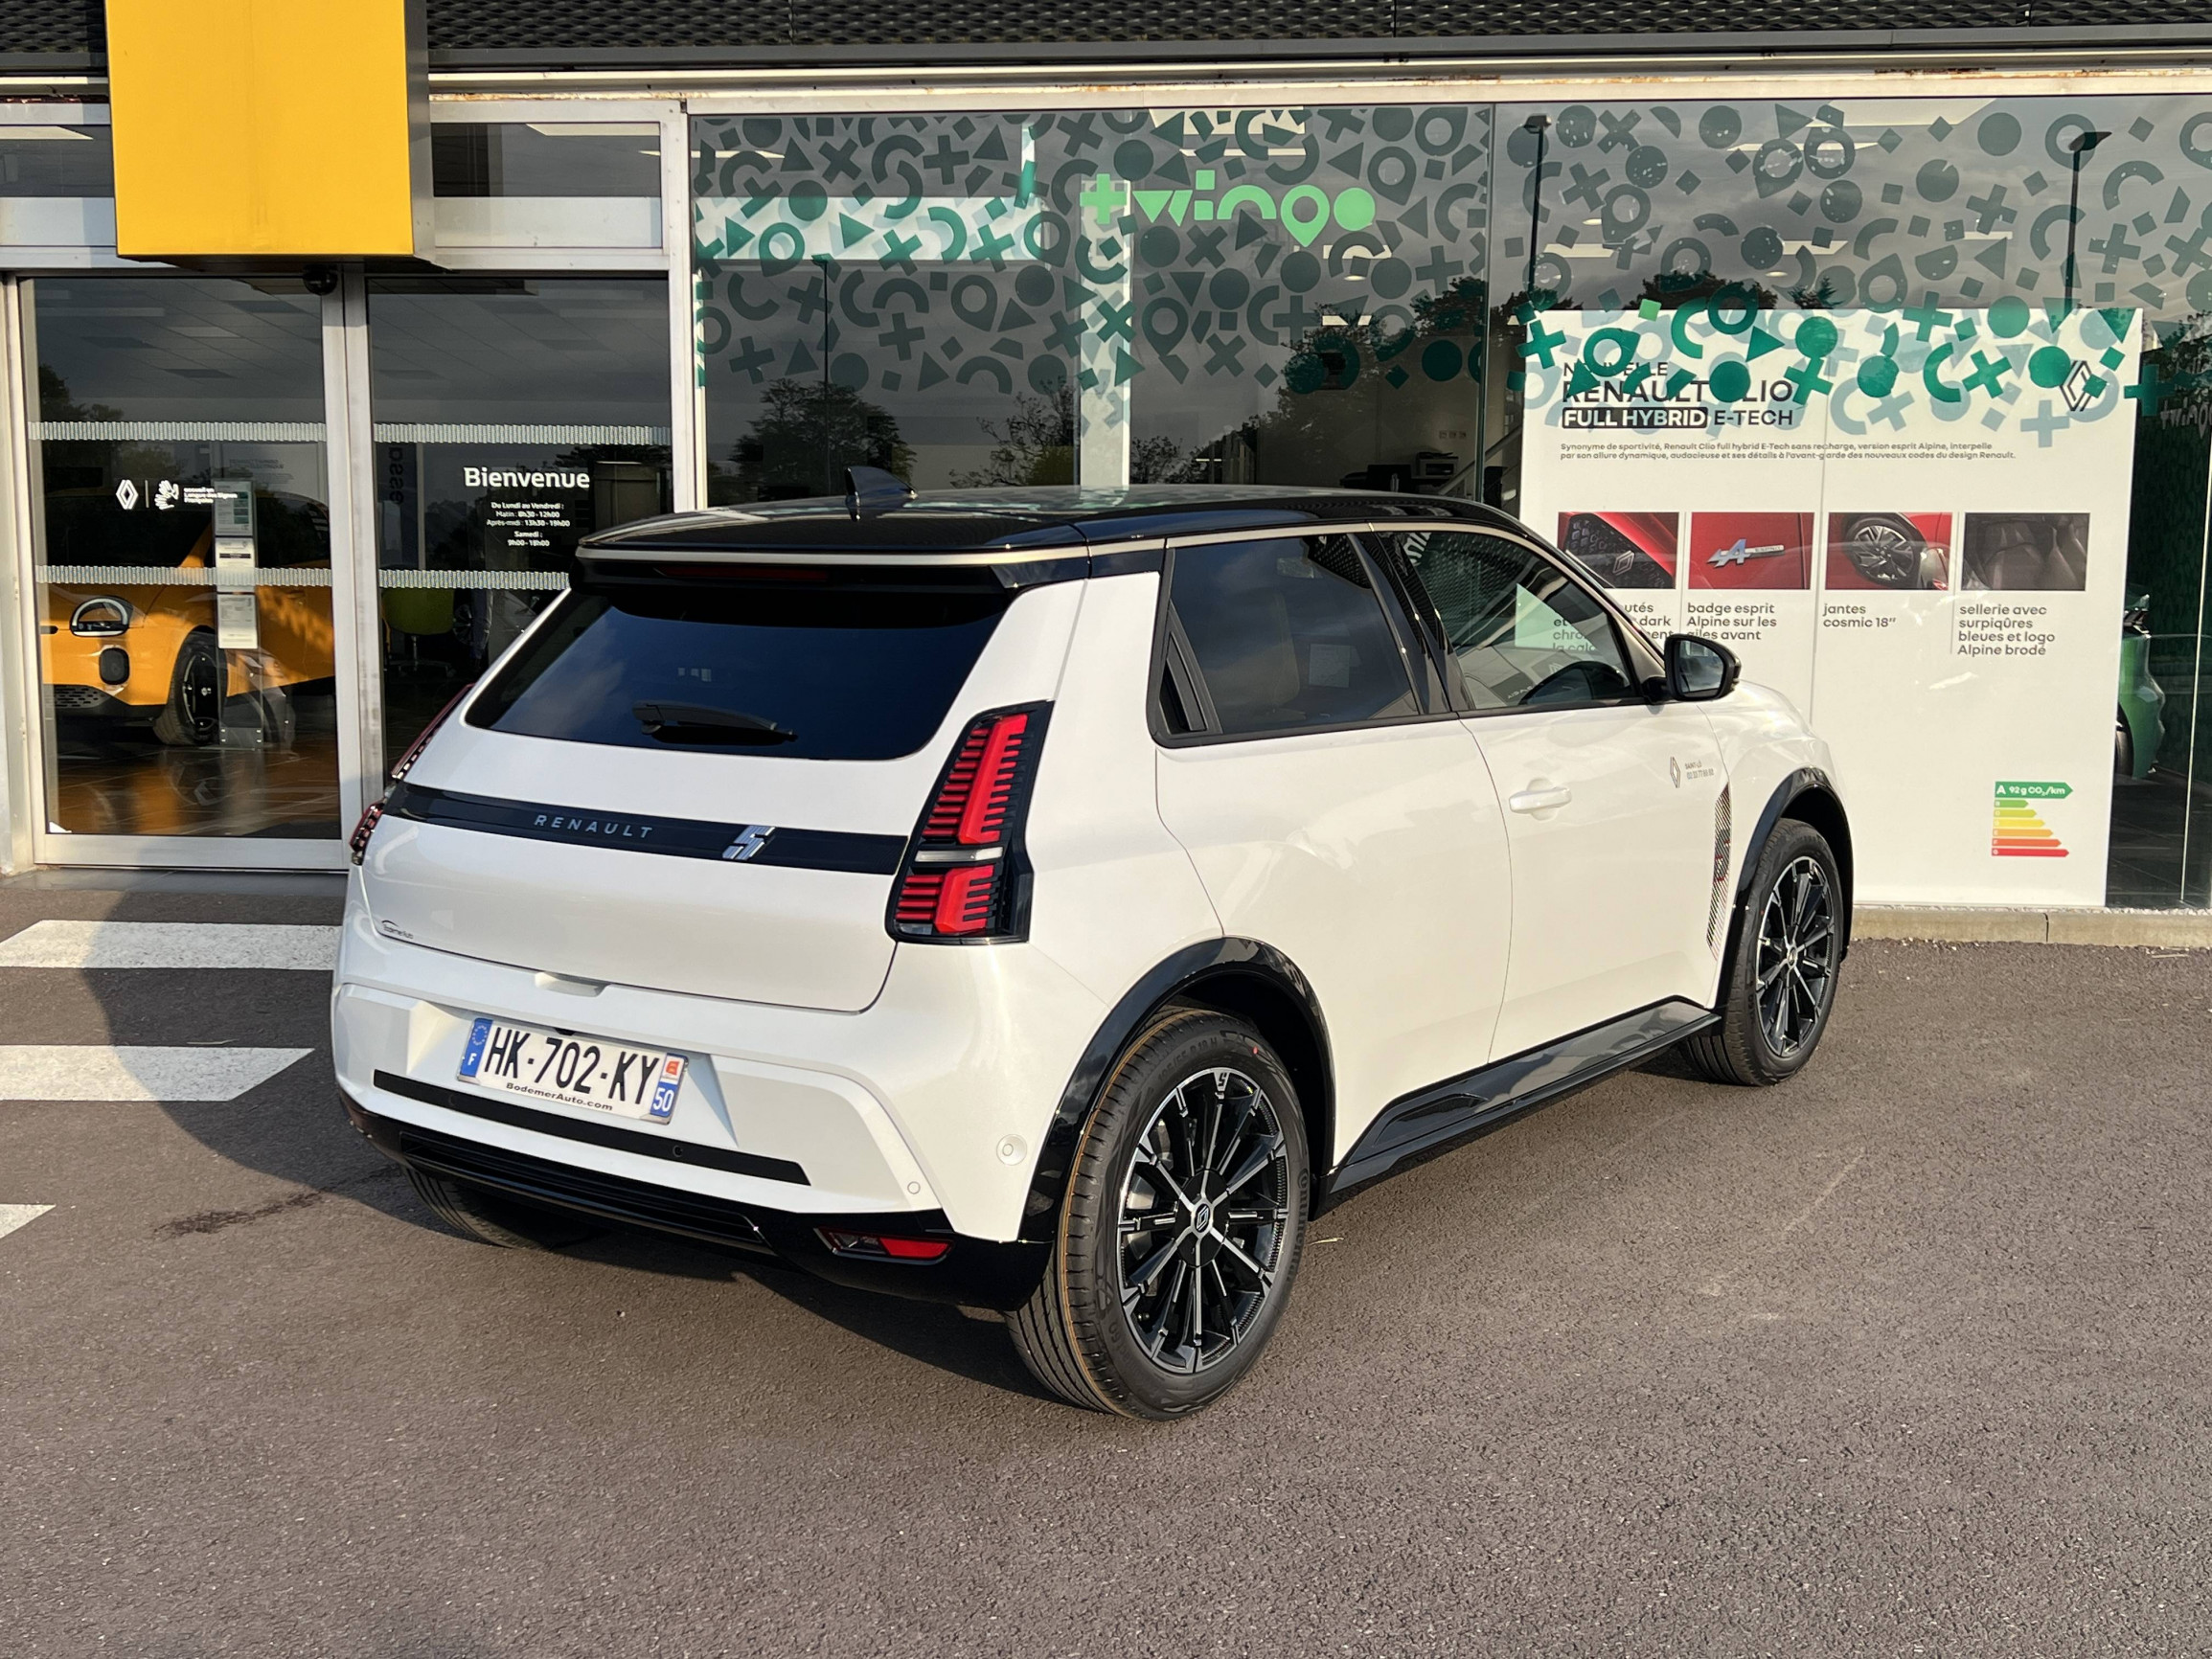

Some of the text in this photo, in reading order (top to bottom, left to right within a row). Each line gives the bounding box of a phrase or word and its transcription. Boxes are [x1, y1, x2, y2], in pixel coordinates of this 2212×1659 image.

[1742, 379, 1793, 402] LIO
[1564, 409, 1793, 427] FULL HYBRID E-TECH
[2160, 397, 2212, 440] twing
[1561, 443, 1605, 452] Synonyme
[1732, 443, 1760, 452] hybrid
[1891, 443, 1916, 451] esprit
[1950, 443, 1993, 451] interpelle
[1949, 451, 1978, 461] design
[464, 466, 590, 489] Bienvenue
[1624, 602, 1654, 612] utés
[1687, 602, 1775, 616] badge esprit
[1822, 602, 1866, 617] jantes
[1959, 603, 2047, 615] sellerie avec
[1639, 615, 1672, 626] dark
[1686, 616, 1777, 628] Alpine sur les
[1823, 617, 1873, 627] cosmic
[1958, 617, 2034, 630] surpiqûres
[1721, 630, 1762, 640] avant
[1958, 630, 2056, 645] bleues et logo
[1957, 644, 2046, 657] Alpine brodé
[1995, 784, 2006, 794] A
[534, 814, 653, 839] RENAULT
[467, 1052, 674, 1113] F 50
[505, 1081, 614, 1112] BodemerAuto.com
